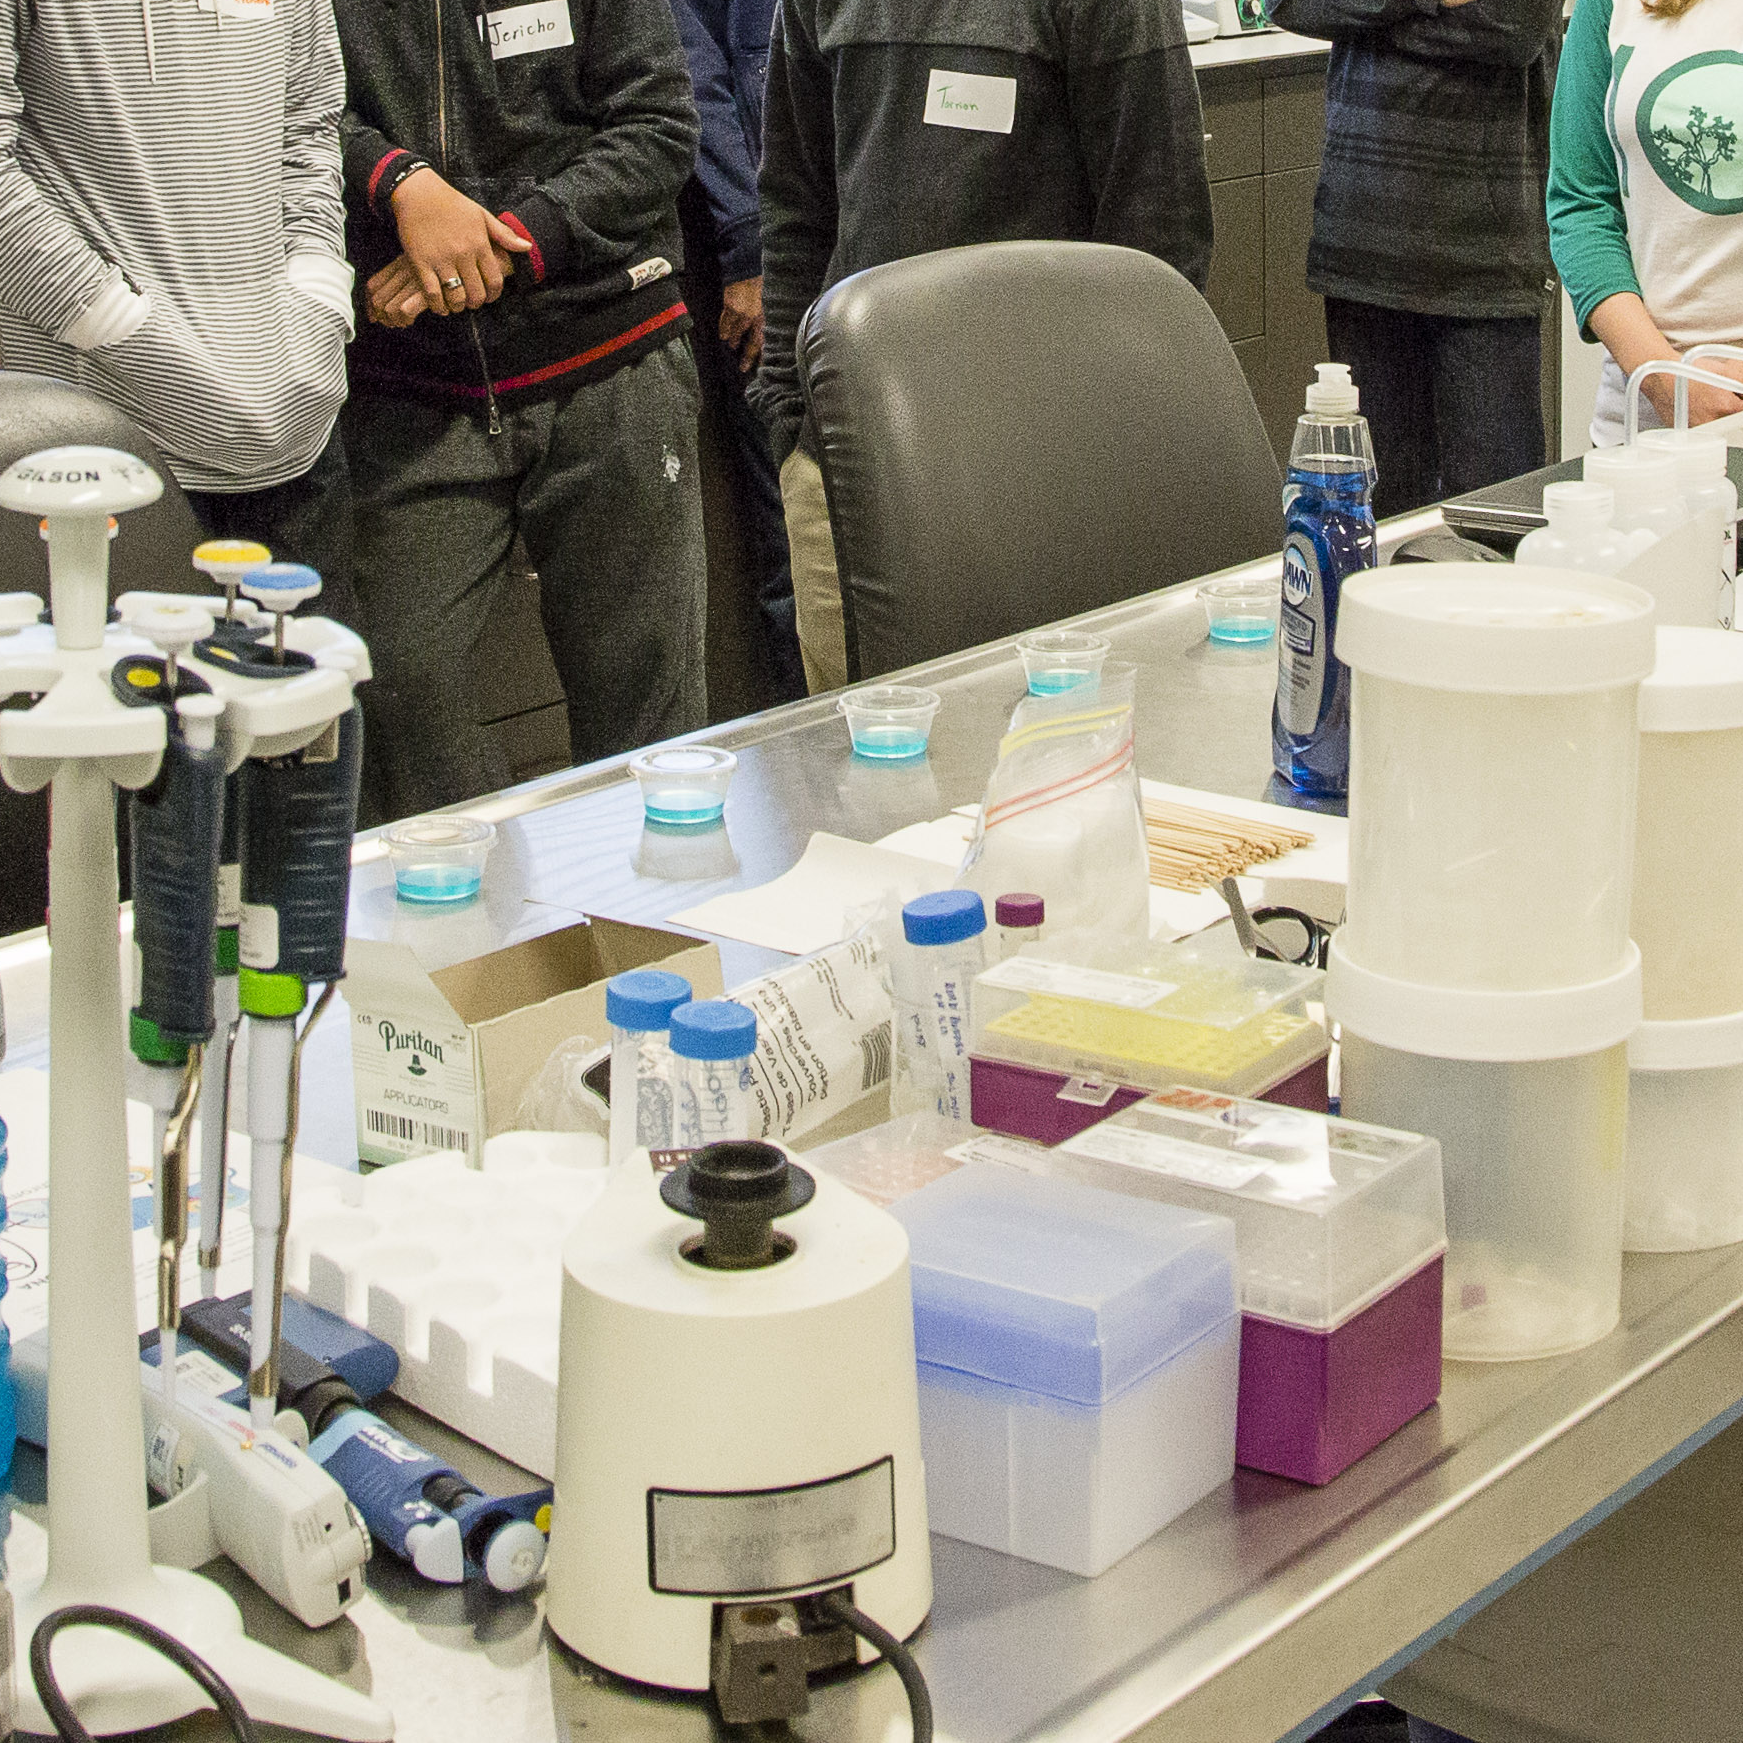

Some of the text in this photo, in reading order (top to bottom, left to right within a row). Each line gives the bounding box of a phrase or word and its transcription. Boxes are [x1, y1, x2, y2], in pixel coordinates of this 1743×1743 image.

[488, 18, 555, 46] Jericho
[18, 468, 100, 483] GILSON
[378, 1020, 445, 1065] Puritan
[798, 1035, 812, 1052] en
[383, 1088, 450, 1115] APPLICATORS
